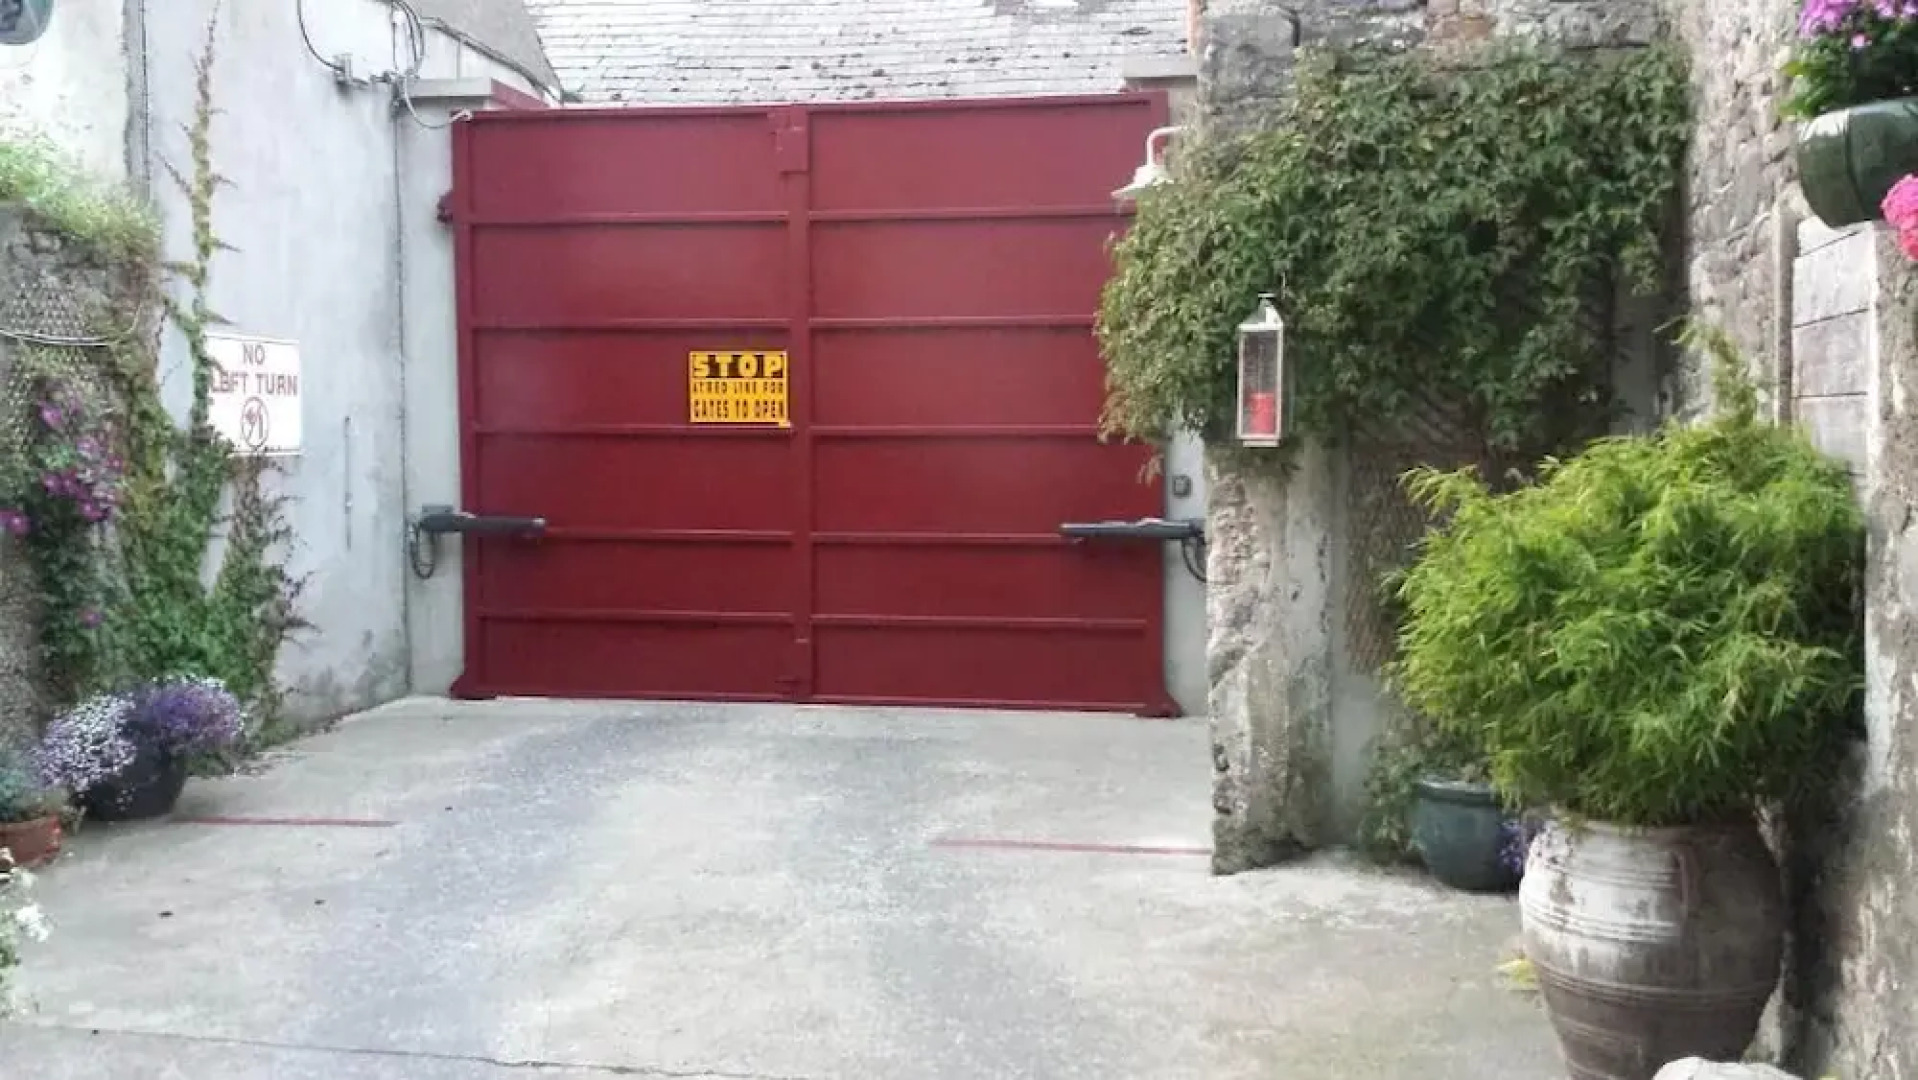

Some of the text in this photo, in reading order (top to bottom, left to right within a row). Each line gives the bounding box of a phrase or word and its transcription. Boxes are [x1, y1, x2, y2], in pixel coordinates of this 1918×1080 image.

[242, 343, 265, 366] NO
[693, 354, 783, 378] STOP
[211, 370, 298, 396] LEFT TURN
[693, 399, 784, 418] GATES TO OPEN
